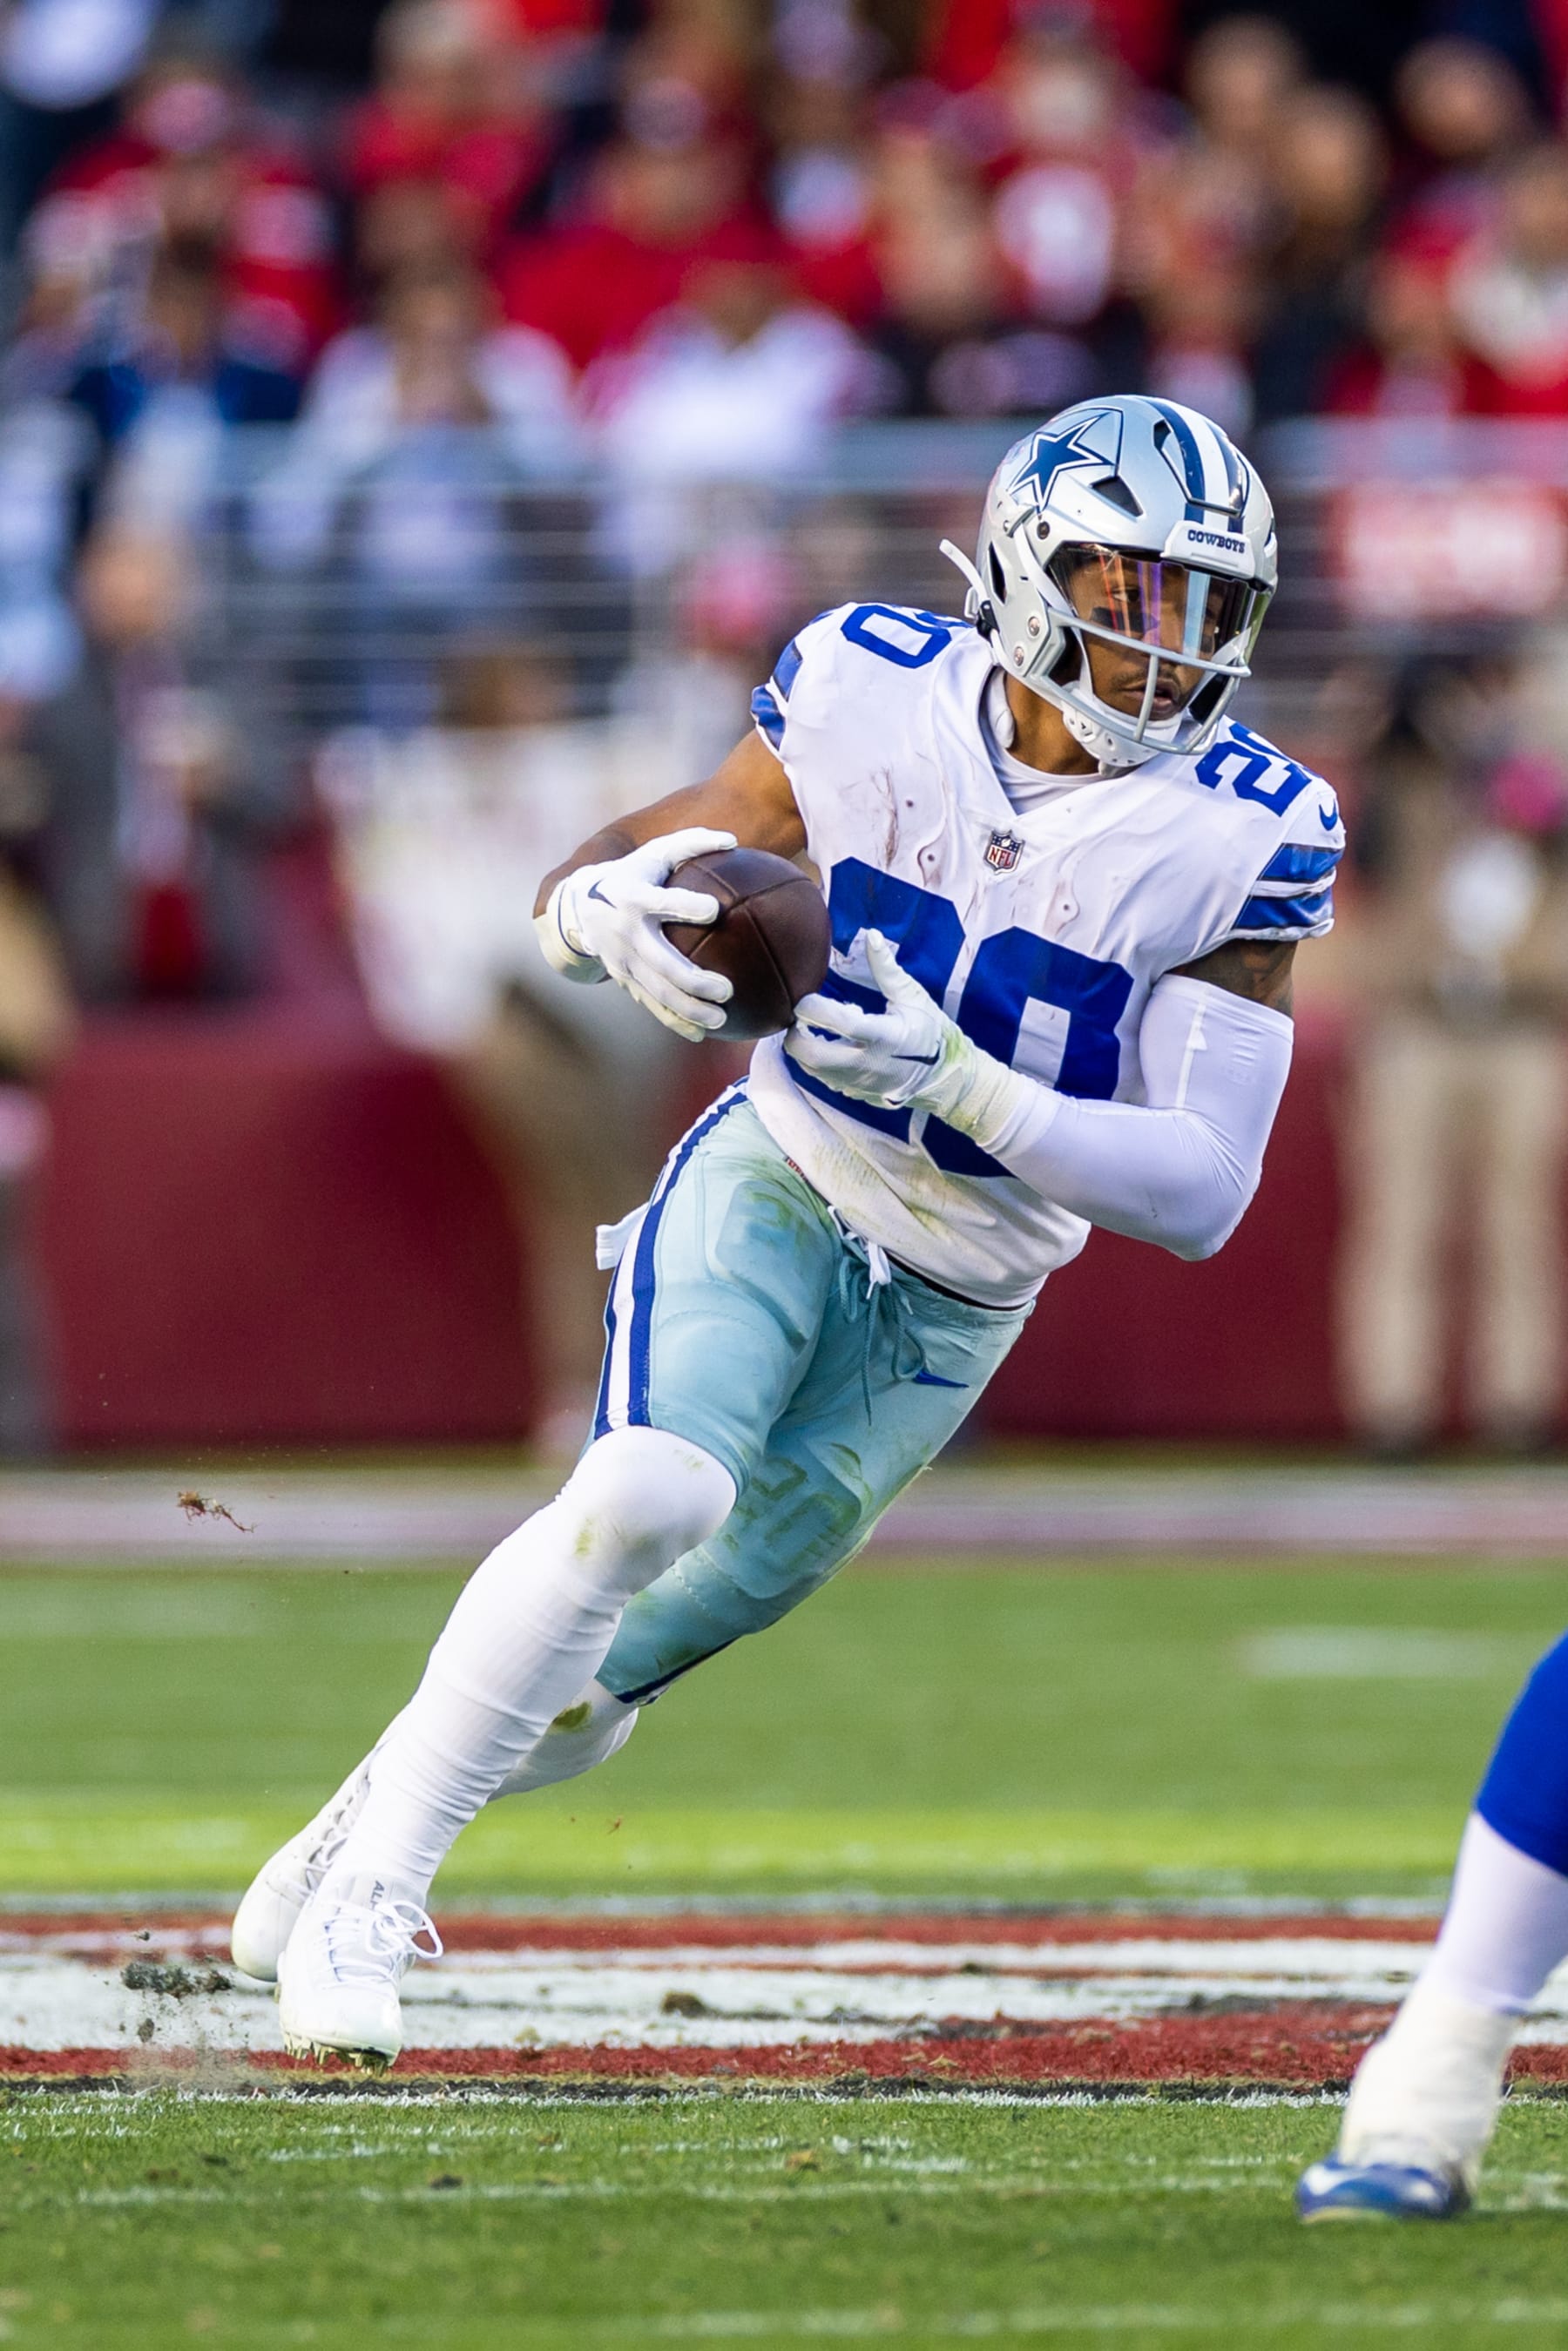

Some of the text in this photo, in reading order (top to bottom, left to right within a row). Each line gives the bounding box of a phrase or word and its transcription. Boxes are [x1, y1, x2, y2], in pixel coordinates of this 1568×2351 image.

[1187, 529, 1245, 554] COWBOYS
[989, 846, 1014, 868] NFL
[784, 856, 1134, 1179] 20
